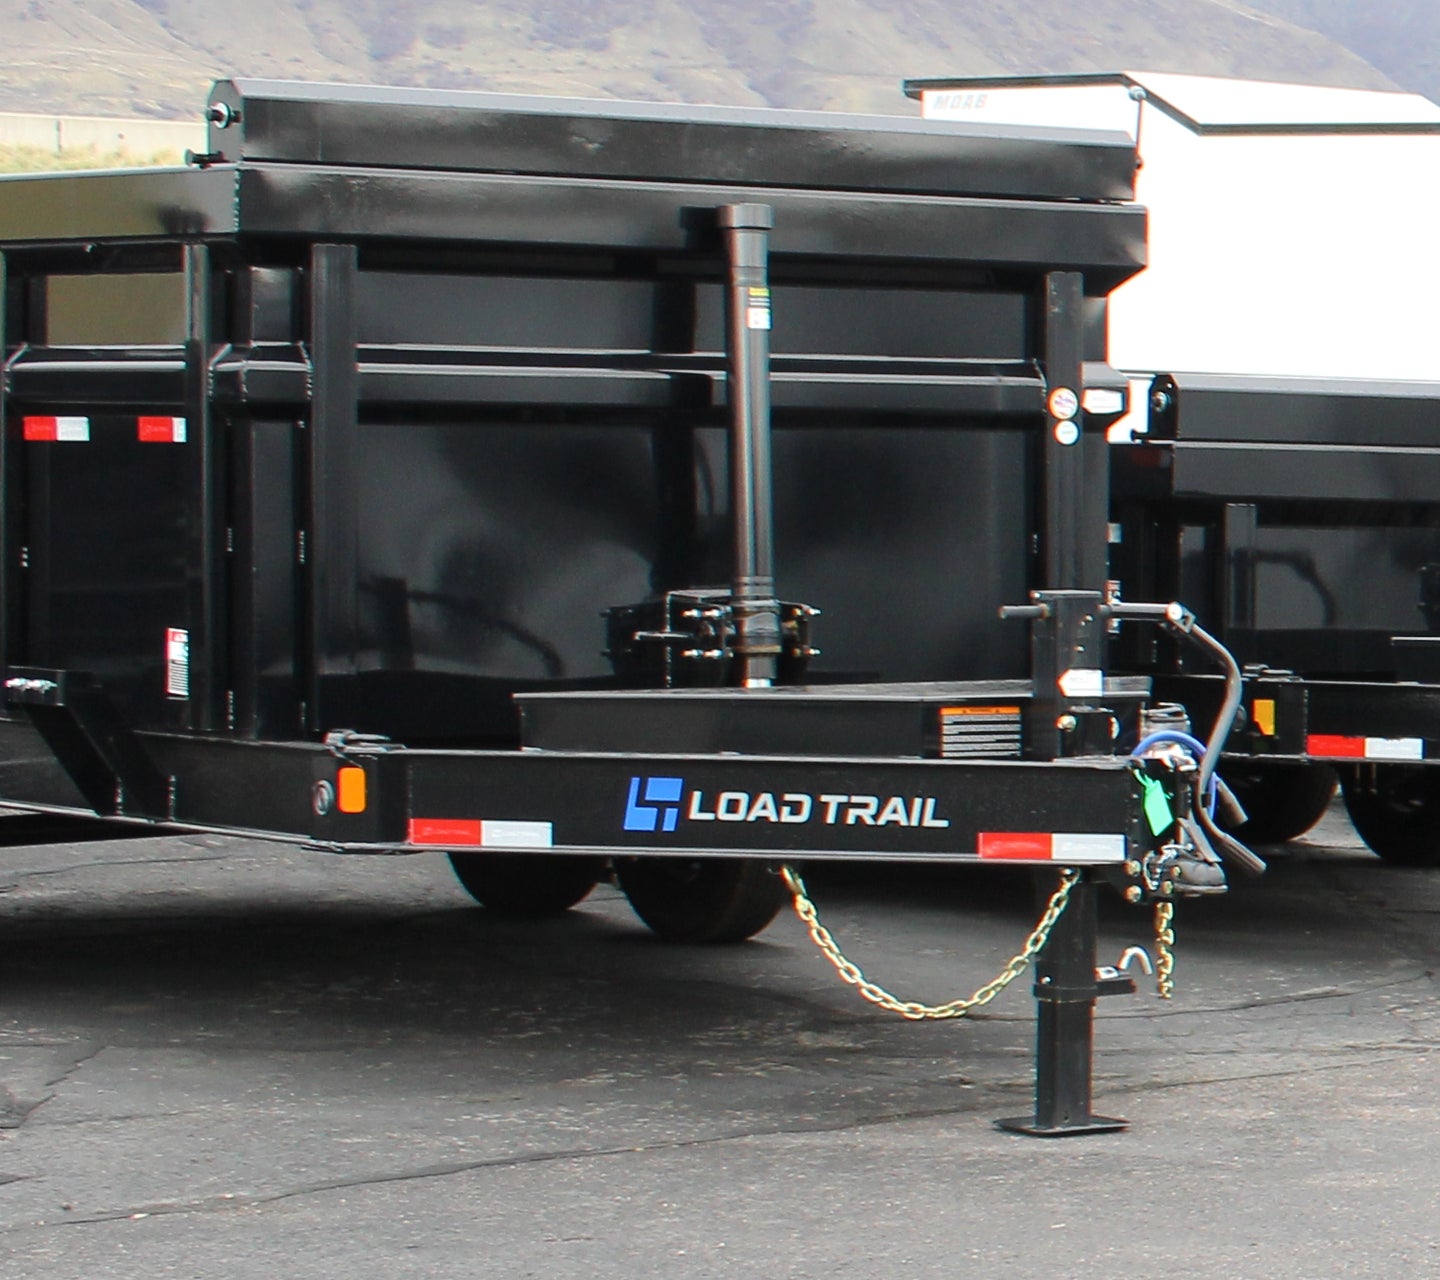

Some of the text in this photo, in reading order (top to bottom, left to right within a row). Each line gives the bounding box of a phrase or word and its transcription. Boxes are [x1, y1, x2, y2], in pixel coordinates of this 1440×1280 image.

[932, 94, 988, 110] MOAB
[689, 790, 950, 828] LOAD TRAIL
